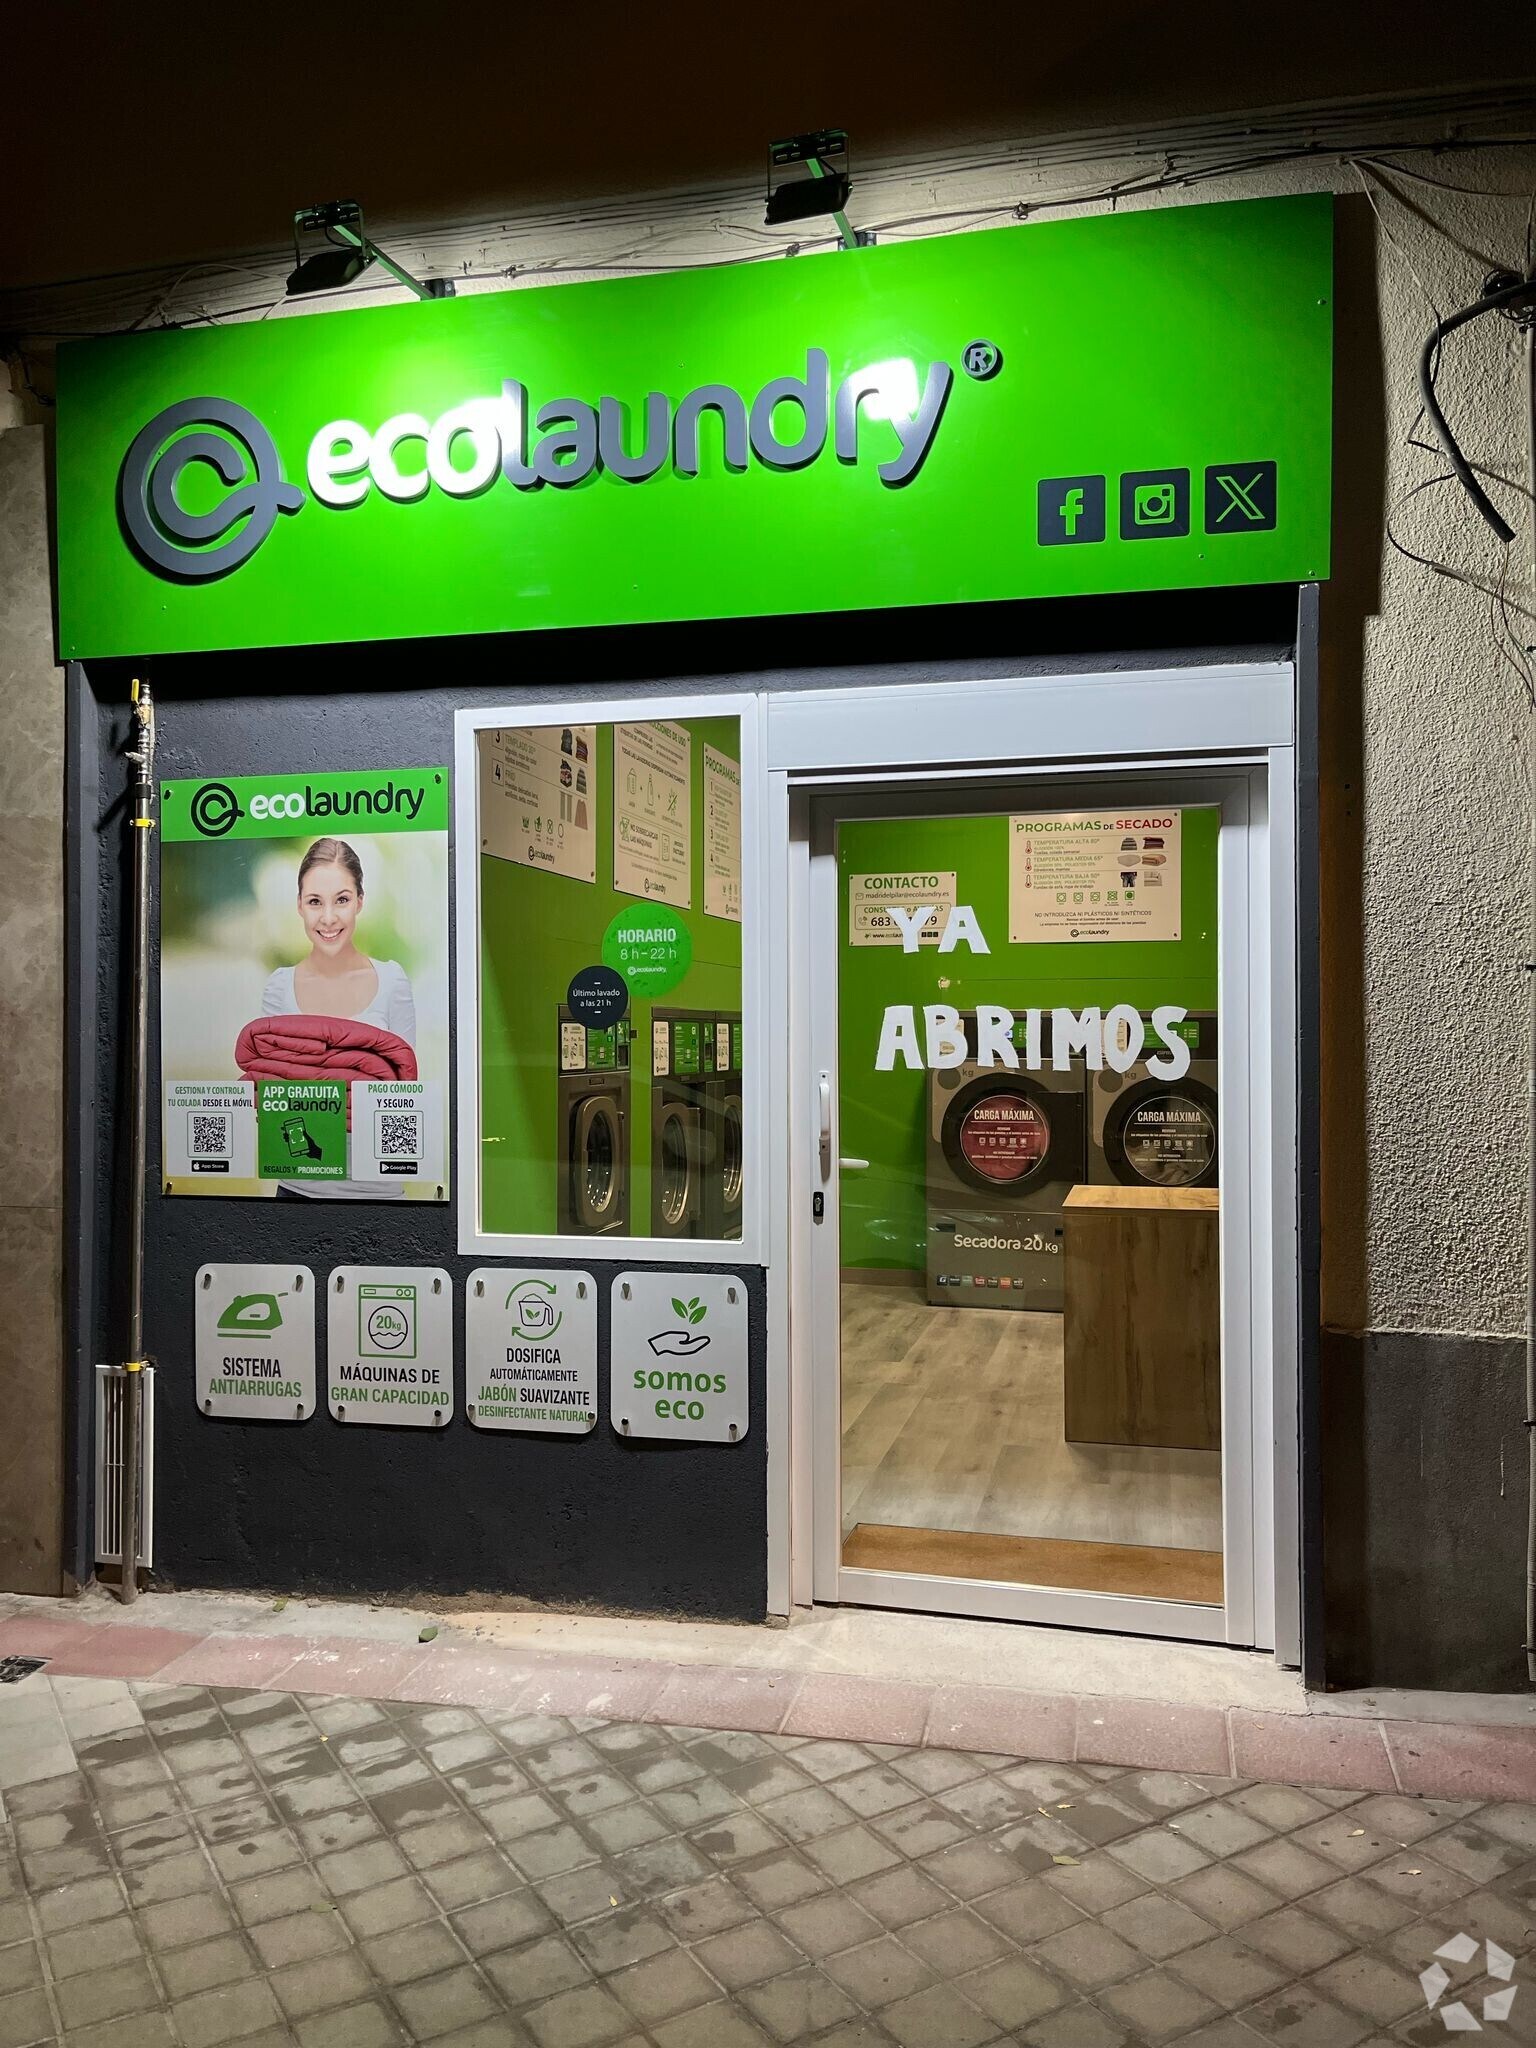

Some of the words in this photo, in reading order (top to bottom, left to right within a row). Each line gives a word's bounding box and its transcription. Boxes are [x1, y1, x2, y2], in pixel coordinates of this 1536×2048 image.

[306, 347, 951, 507] ecolaundry
[496, 730, 500, 743] 3
[495, 764, 501, 780] 4
[250, 781, 425, 820] ecolaundry
[1016, 821, 1102, 833] PROGRAMAS
[1116, 818, 1173, 830] SECADO
[864, 876, 939, 889] CONTACTO
[870, 916, 891, 927] 683
[618, 928, 677, 943] HORARIO
[885, 905, 992, 954] YA
[620, 949, 628, 960] 8
[631, 948, 639, 960] h
[650, 947, 665, 960] 22
[669, 947, 677, 959] h
[573, 989, 596, 997] Último
[597, 989, 621, 997] lavado
[875, 1004, 1191, 1081] ABRIMOS
[962, 1069, 974, 1077] kg
[1124, 1071, 1137, 1080] kg
[175, 1086, 206, 1095] GESTIONA
[207, 1086, 212, 1094] Y
[212, 1086, 245, 1095] CONTROLA
[263, 1086, 285, 1099] APP
[287, 1086, 340, 1099] GRATUITA
[368, 1084, 388, 1094] PAGO
[389, 1082, 424, 1094] CÓMODO
[168, 1099, 176, 1107] TU
[177, 1099, 201, 1107] COLADA
[202, 1099, 223, 1107] DESDE
[224, 1099, 232, 1107] EL
[232, 1097, 253, 1107] MÓVIL
[262, 1098, 342, 1115] ecolaundry
[376, 1099, 382, 1108] Y
[383, 1098, 414, 1108] SEGURO
[974, 1109, 1000, 1120] CARGA
[1001, 1108, 1035, 1121] MÁXIMA
[1137, 1111, 1165, 1122] CARGA
[1166, 1109, 1201, 1122] MÁXIMA
[264, 1165, 292, 1174] REGALOS
[297, 1166, 344, 1175] PROMOCIONES
[954, 1234, 1021, 1251] Secadora
[1023, 1237, 1043, 1251] 20
[1045, 1242, 1059, 1254] Kg
[506, 1347, 561, 1364] DOSIFICA
[222, 1357, 282, 1378] SISTEMA
[340, 1363, 417, 1384] MÁQUINAS
[423, 1370, 440, 1384] DE
[490, 1366, 578, 1382] AUTOMÁTICAMENTE
[209, 1378, 302, 1398] ANTIARRUGAS
[633, 1369, 727, 1393] somos
[331, 1386, 368, 1403] GRAN
[372, 1389, 450, 1406] CAPACIDAD
[478, 1384, 517, 1402] JABÓN
[520, 1388, 590, 1406] SUAVIZANTE
[478, 1405, 547, 1421] DESINFECTANTE
[549, 1408, 589, 1423] NATURAL
[654, 1399, 705, 1421] eco
